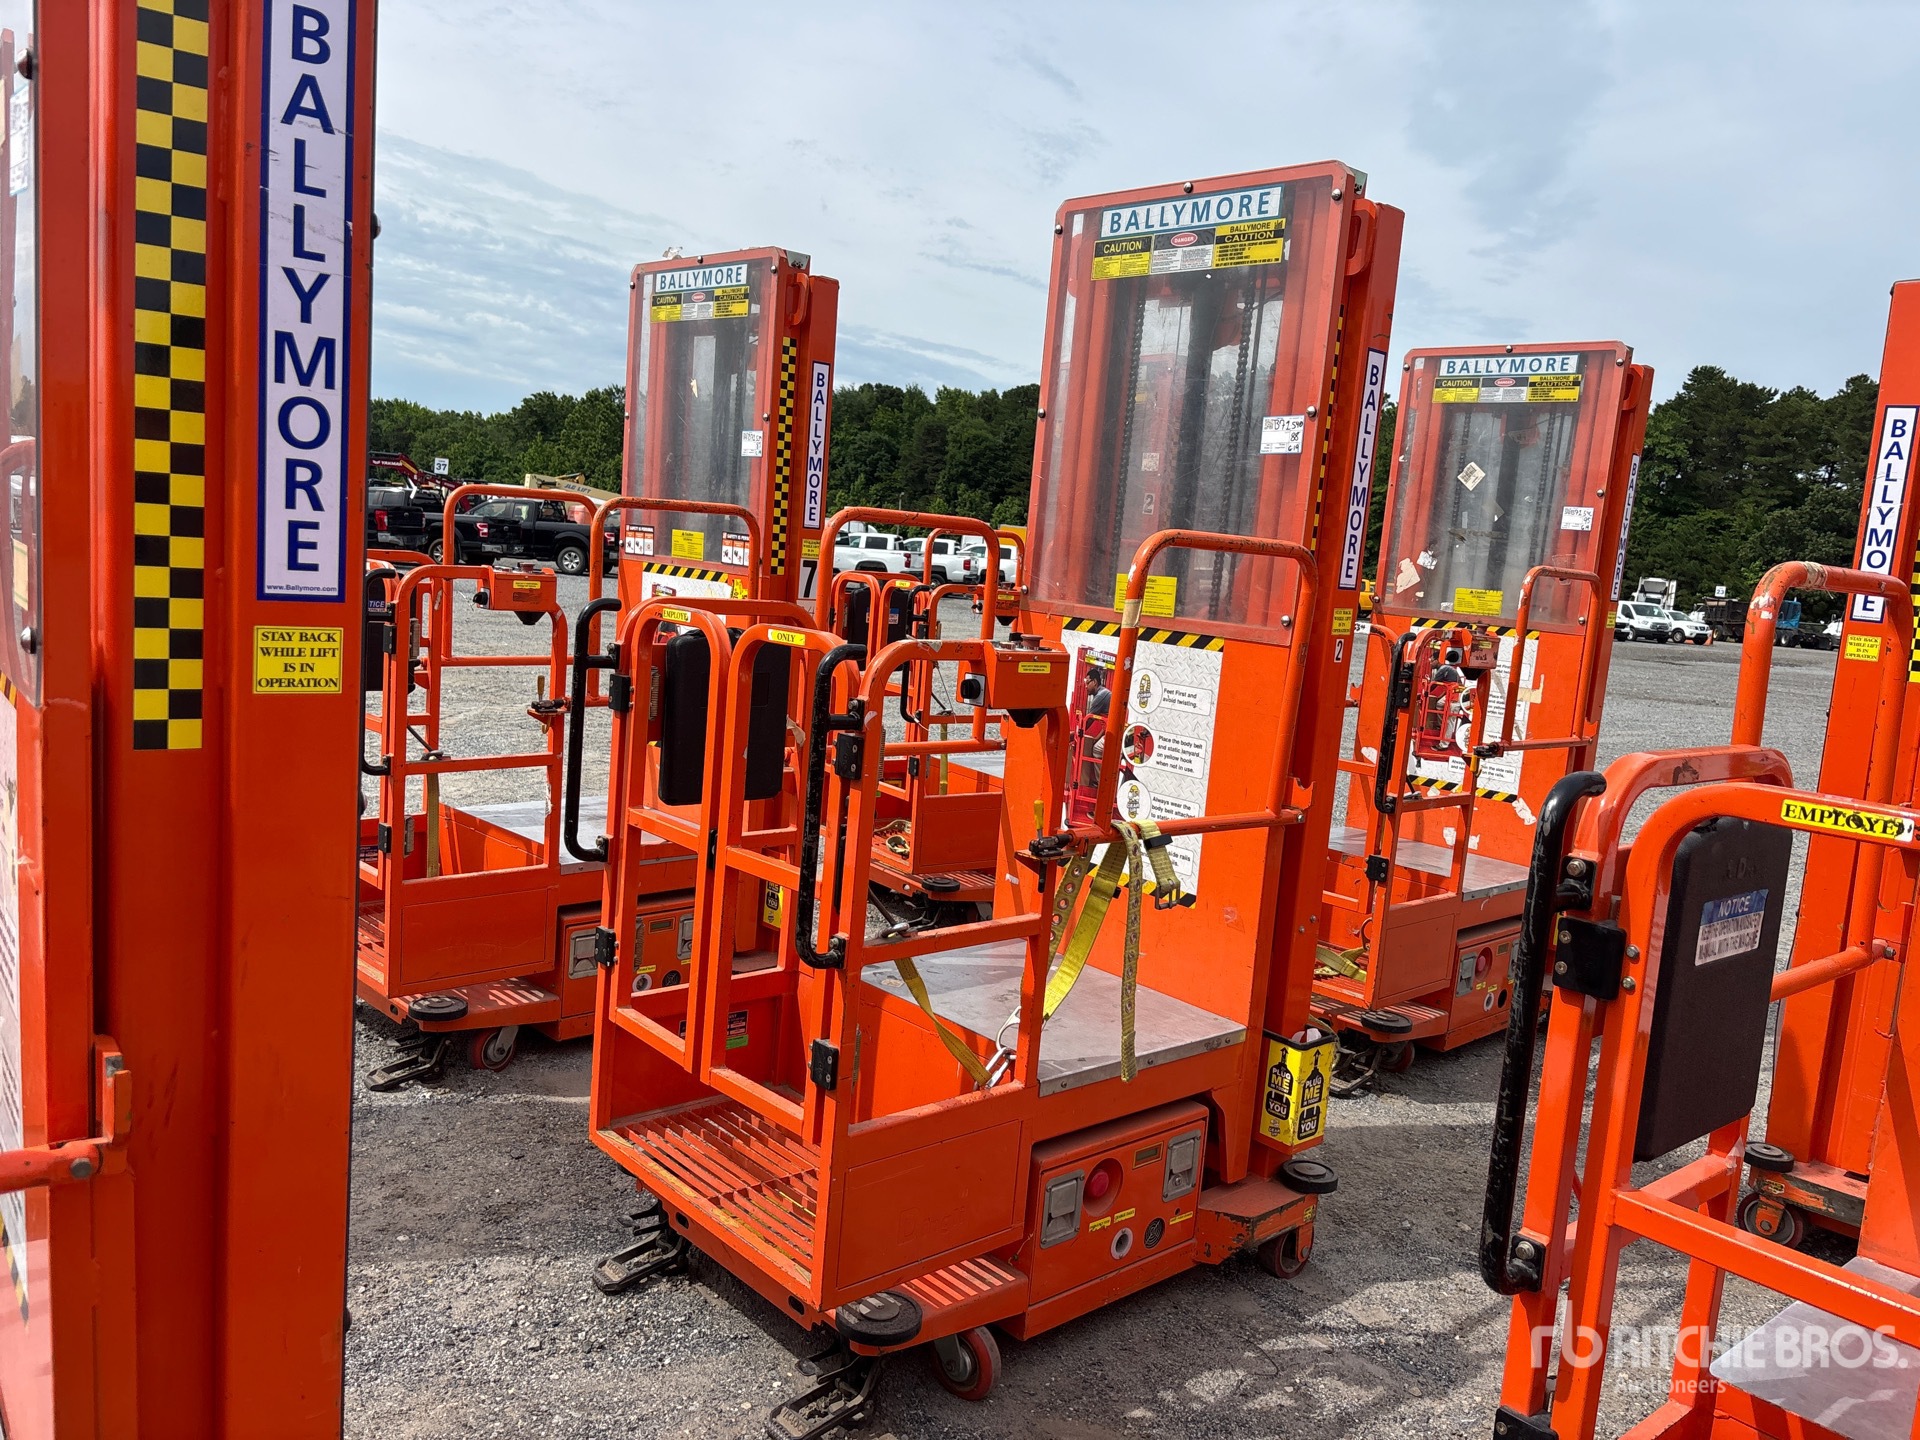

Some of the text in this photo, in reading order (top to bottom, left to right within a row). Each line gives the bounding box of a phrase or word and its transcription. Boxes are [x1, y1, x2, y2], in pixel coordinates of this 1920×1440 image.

[1110, 191, 1271, 234] BALLYMORE
[1230, 222, 1271, 233] BALLYMORE
[1225, 231, 1275, 243] CAUTION
[1103, 240, 1142, 254] CAUTION
[660, 266, 743, 290] BALLYMORE
[274, 4, 336, 573] BALLYMORE
[656, 295, 677, 305] CAUTION
[1446, 357, 1570, 374] BALLYMORE
[1442, 379, 1473, 387] CAUTION
[809, 372, 825, 522] BALLYMORE
[436, 463, 447, 471] 37
[1345, 364, 1380, 579] BALLYMORE
[1862, 419, 1907, 612] BALLYMOE
[803, 560, 818, 598] 7
[267, 584, 337, 592] www.Ballymore.com
[261, 631, 337, 642] STAY BACK
[776, 633, 796, 642] ONLY
[260, 647, 338, 658] WHILE LIFT
[1335, 640, 1343, 661] 2
[284, 662, 315, 672] IS IN
[258, 678, 338, 688] OPERATION
[1175, 690, 1186, 698] First
[1158, 736, 1172, 744] Place
[1180, 740, 1192, 749] body
[1164, 753, 1179, 762] yellow
[1181, 748, 1200, 758] lanyard
[1152, 797, 1169, 806] Always
[1152, 805, 1163, 813] body
[1180, 854, 1190, 862] rails
[1718, 896, 1751, 918] NOTICE
[1272, 1068, 1291, 1079] PLUG
[1272, 1076, 1290, 1090] ME
[1305, 1076, 1322, 1088] PLUG
[1304, 1085, 1321, 1101] ME
[1269, 1102, 1287, 1114] YOU
[1301, 1120, 1317, 1133] YOU
